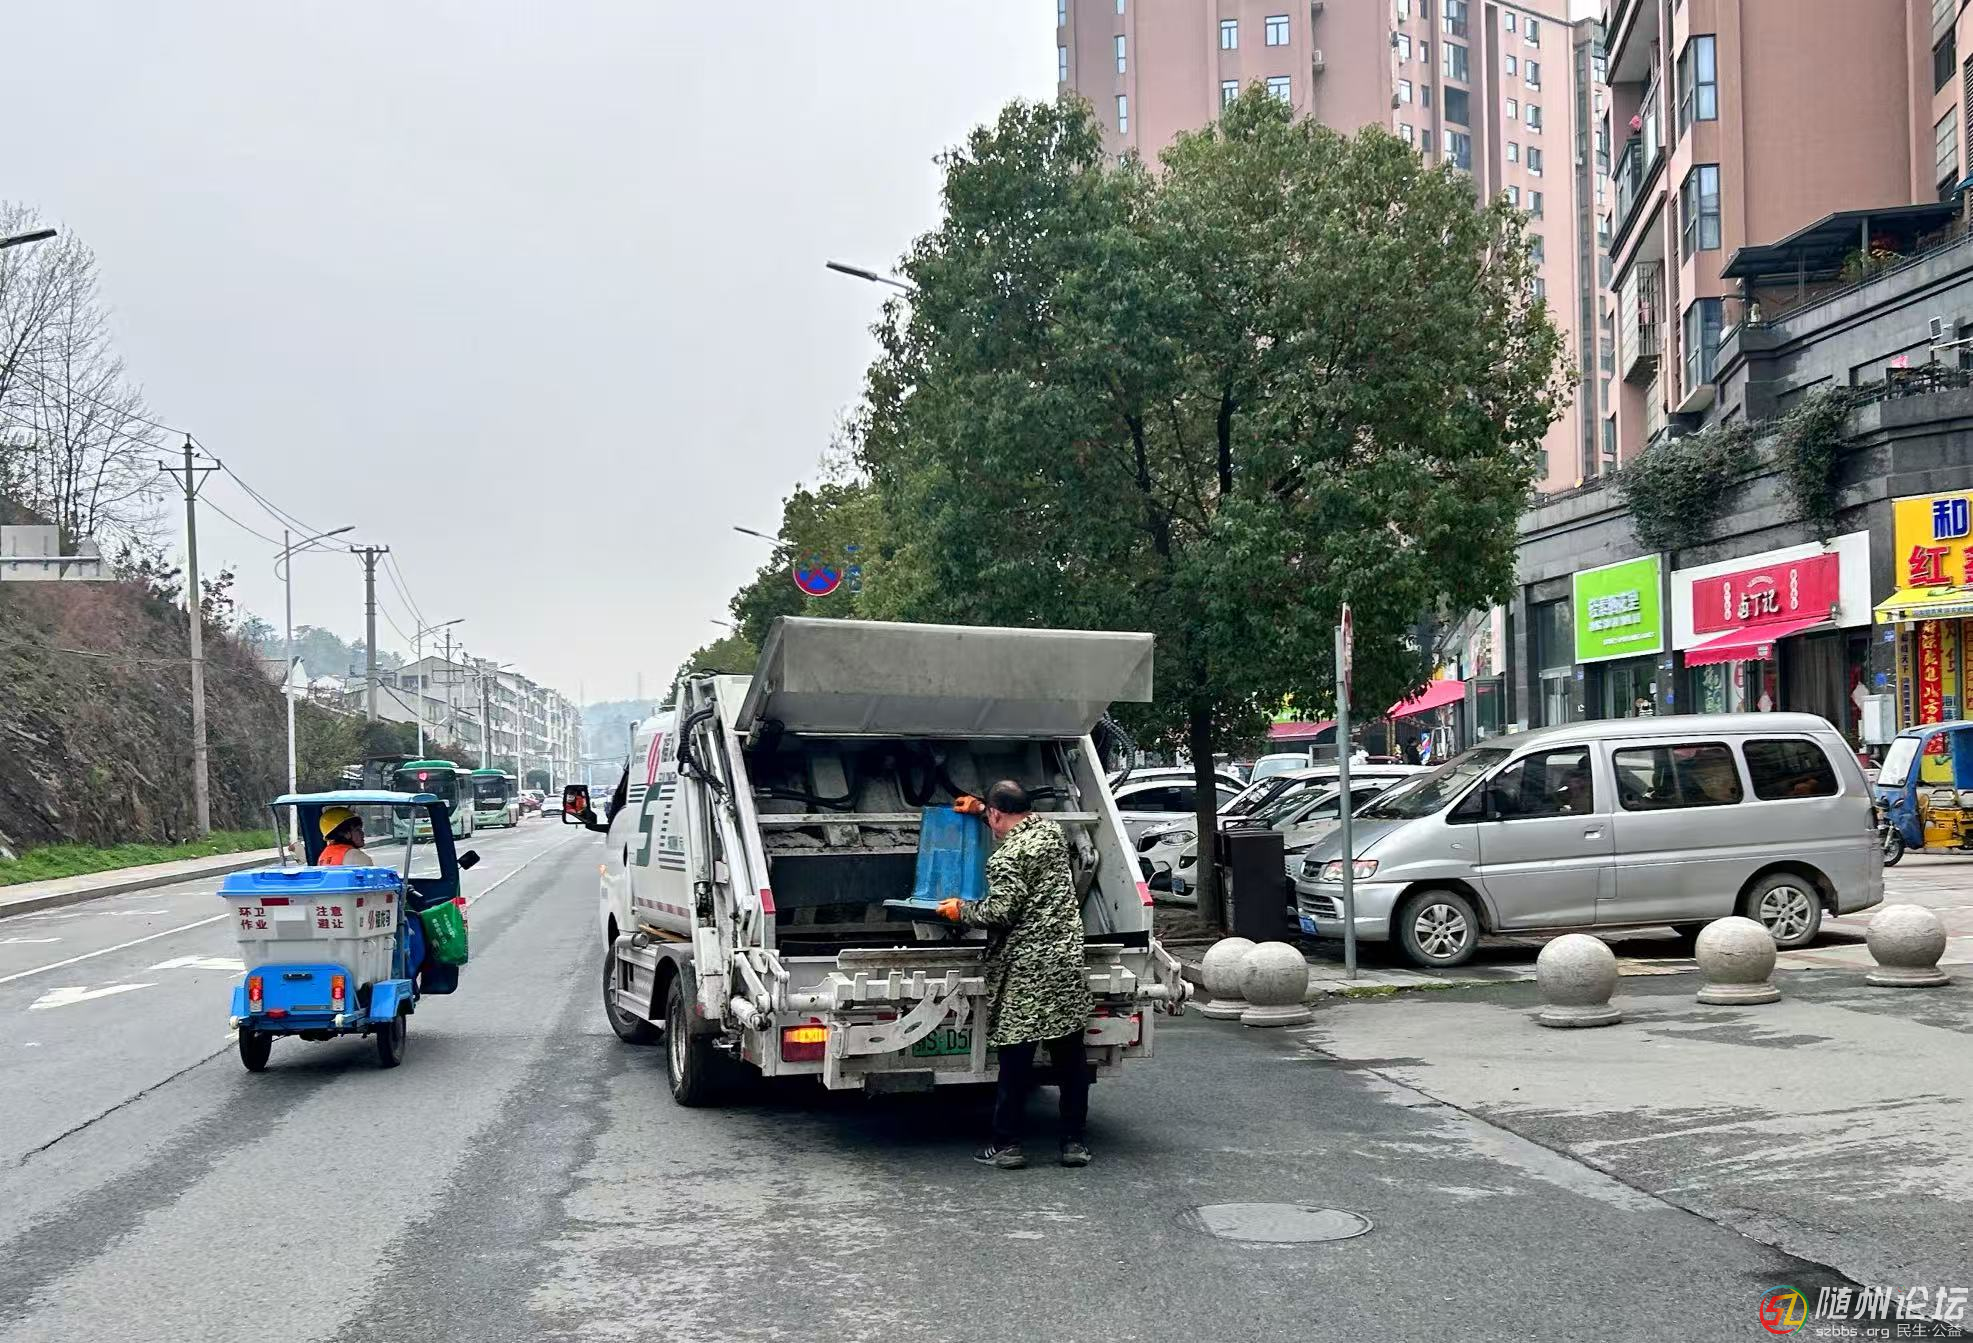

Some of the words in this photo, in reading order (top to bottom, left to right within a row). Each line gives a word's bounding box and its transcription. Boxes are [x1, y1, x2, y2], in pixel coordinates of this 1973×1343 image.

[1932, 498, 1969, 540] 和
[1908, 545, 1973, 587] 红
[238, 907, 266, 917] 环卫
[316, 906, 343, 916] 注意
[240, 919, 269, 930] 作业
[317, 919, 344, 929] 避让
